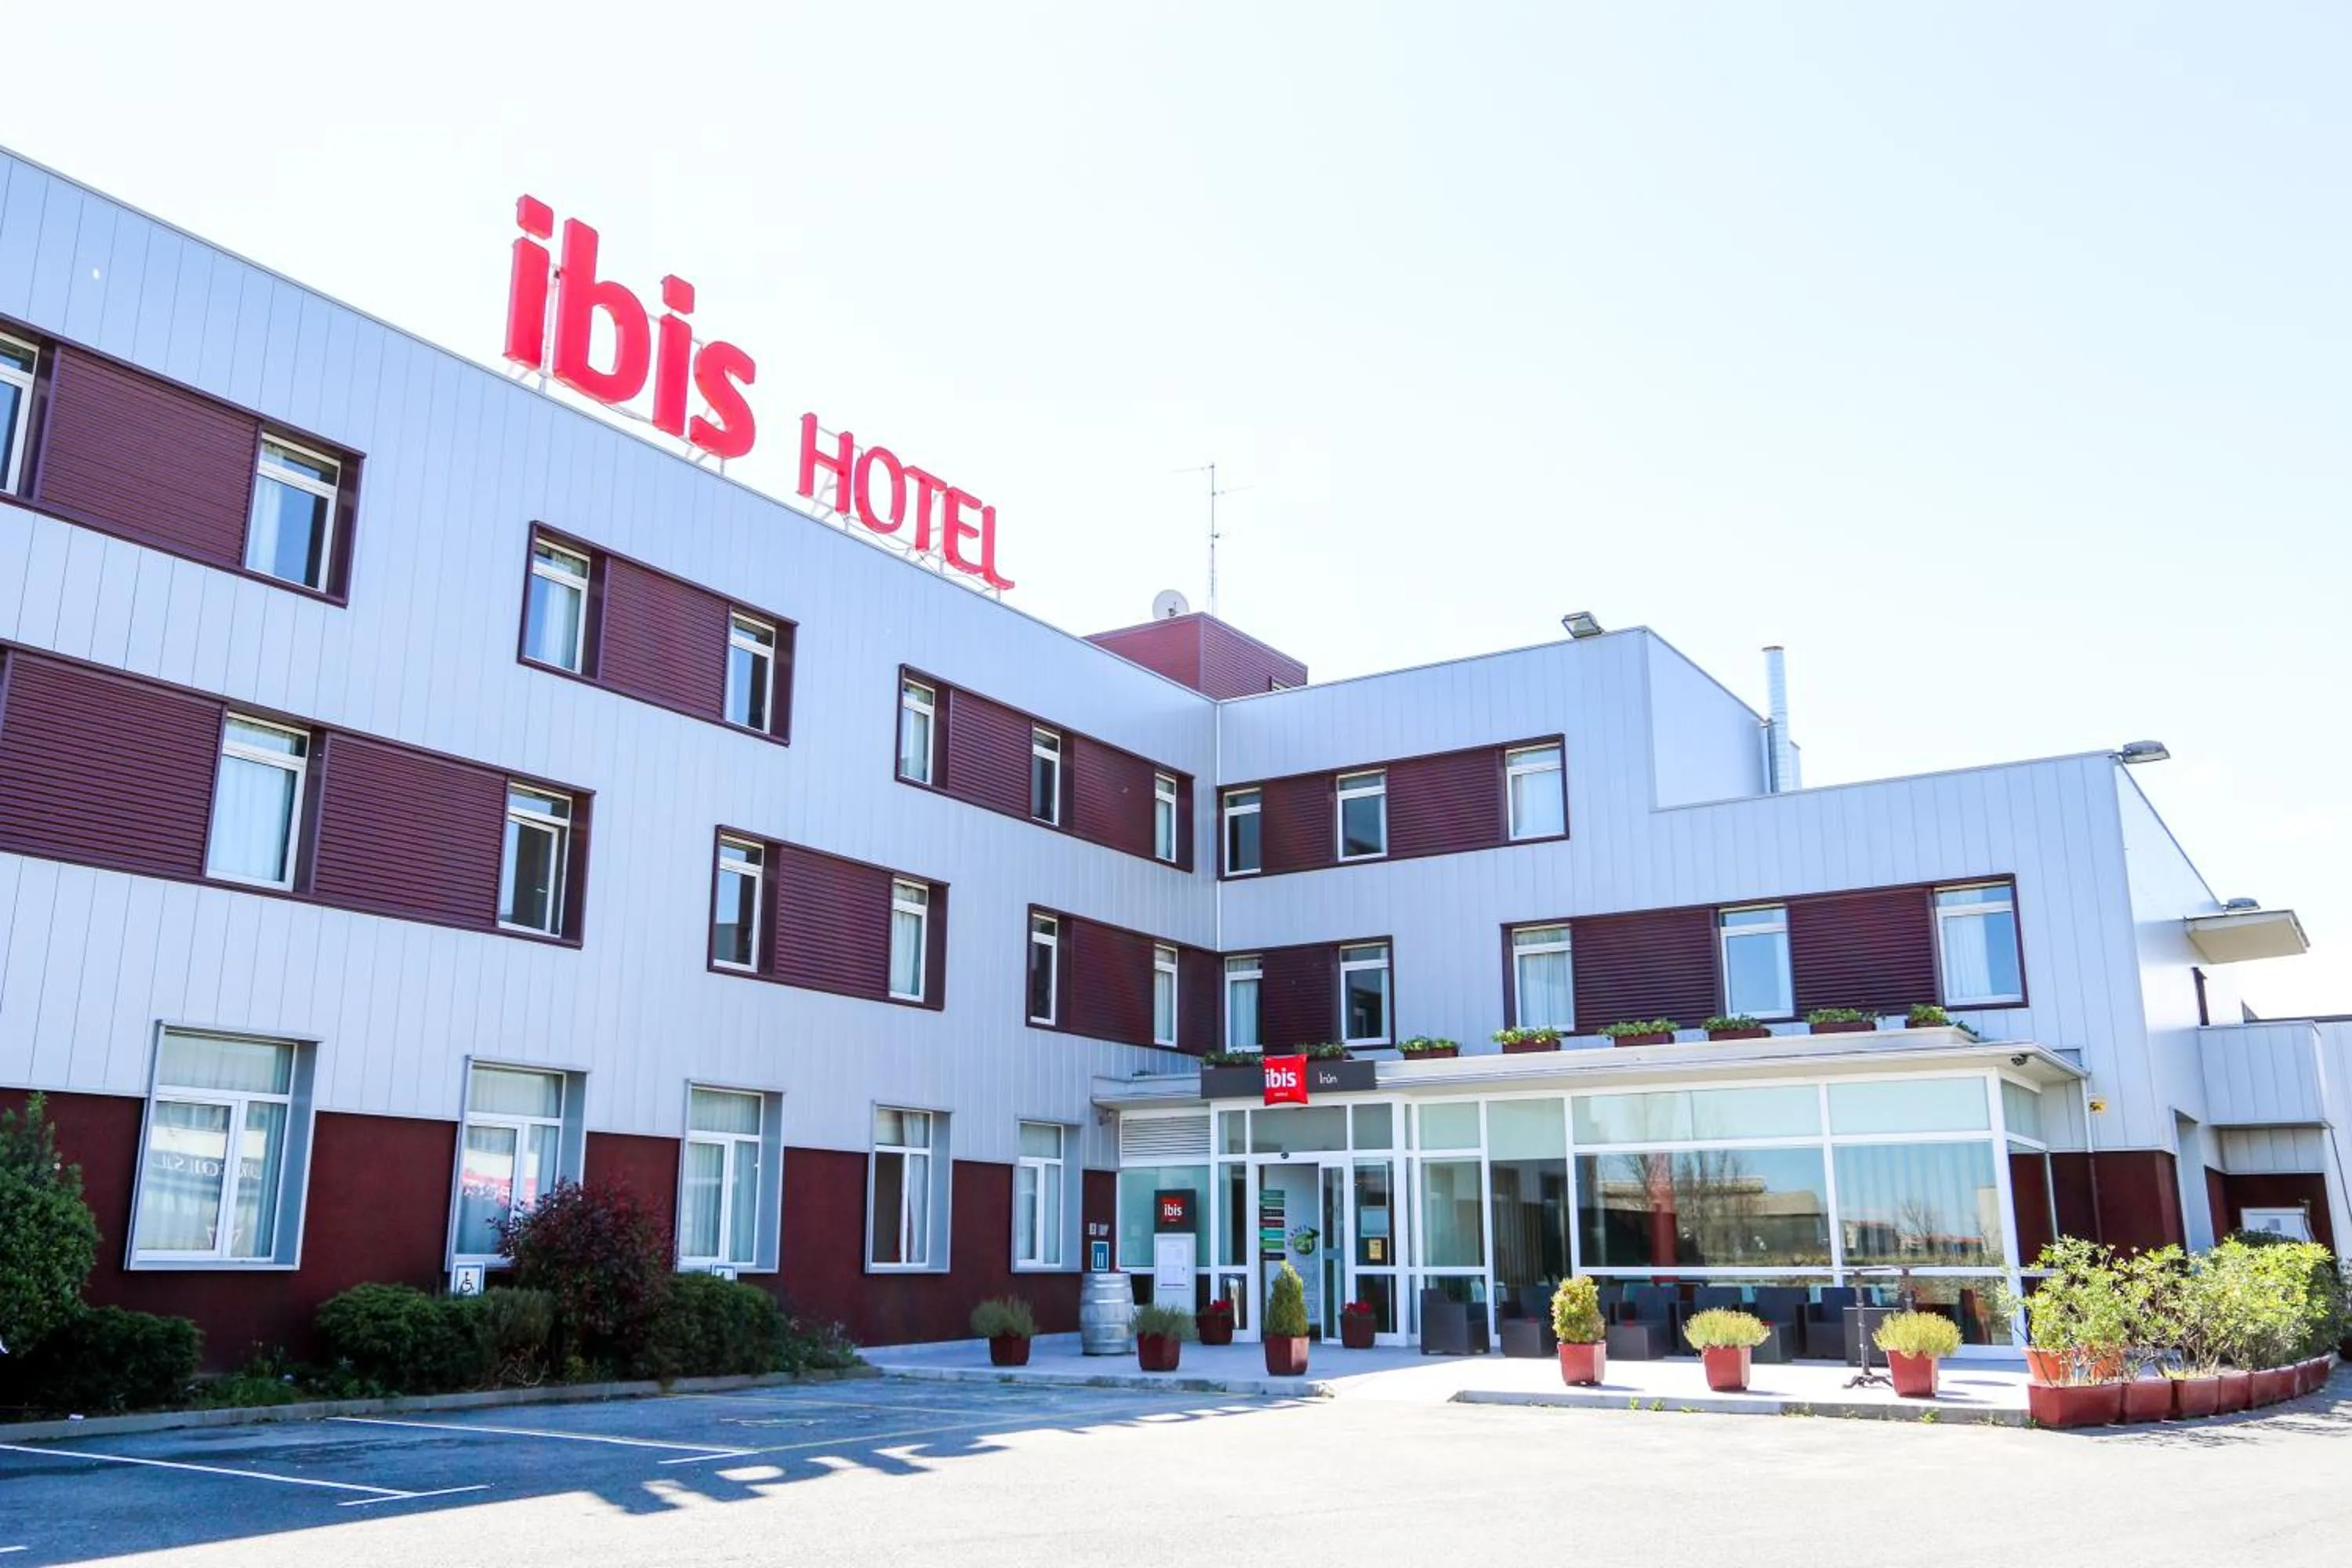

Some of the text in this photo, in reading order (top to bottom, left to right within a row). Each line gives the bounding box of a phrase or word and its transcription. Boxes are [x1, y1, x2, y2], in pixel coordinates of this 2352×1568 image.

[503, 194, 1015, 590] ibis HOTEL
[1265, 1067, 1298, 1088] ibis
[1164, 1203, 1182, 1216] ibis
